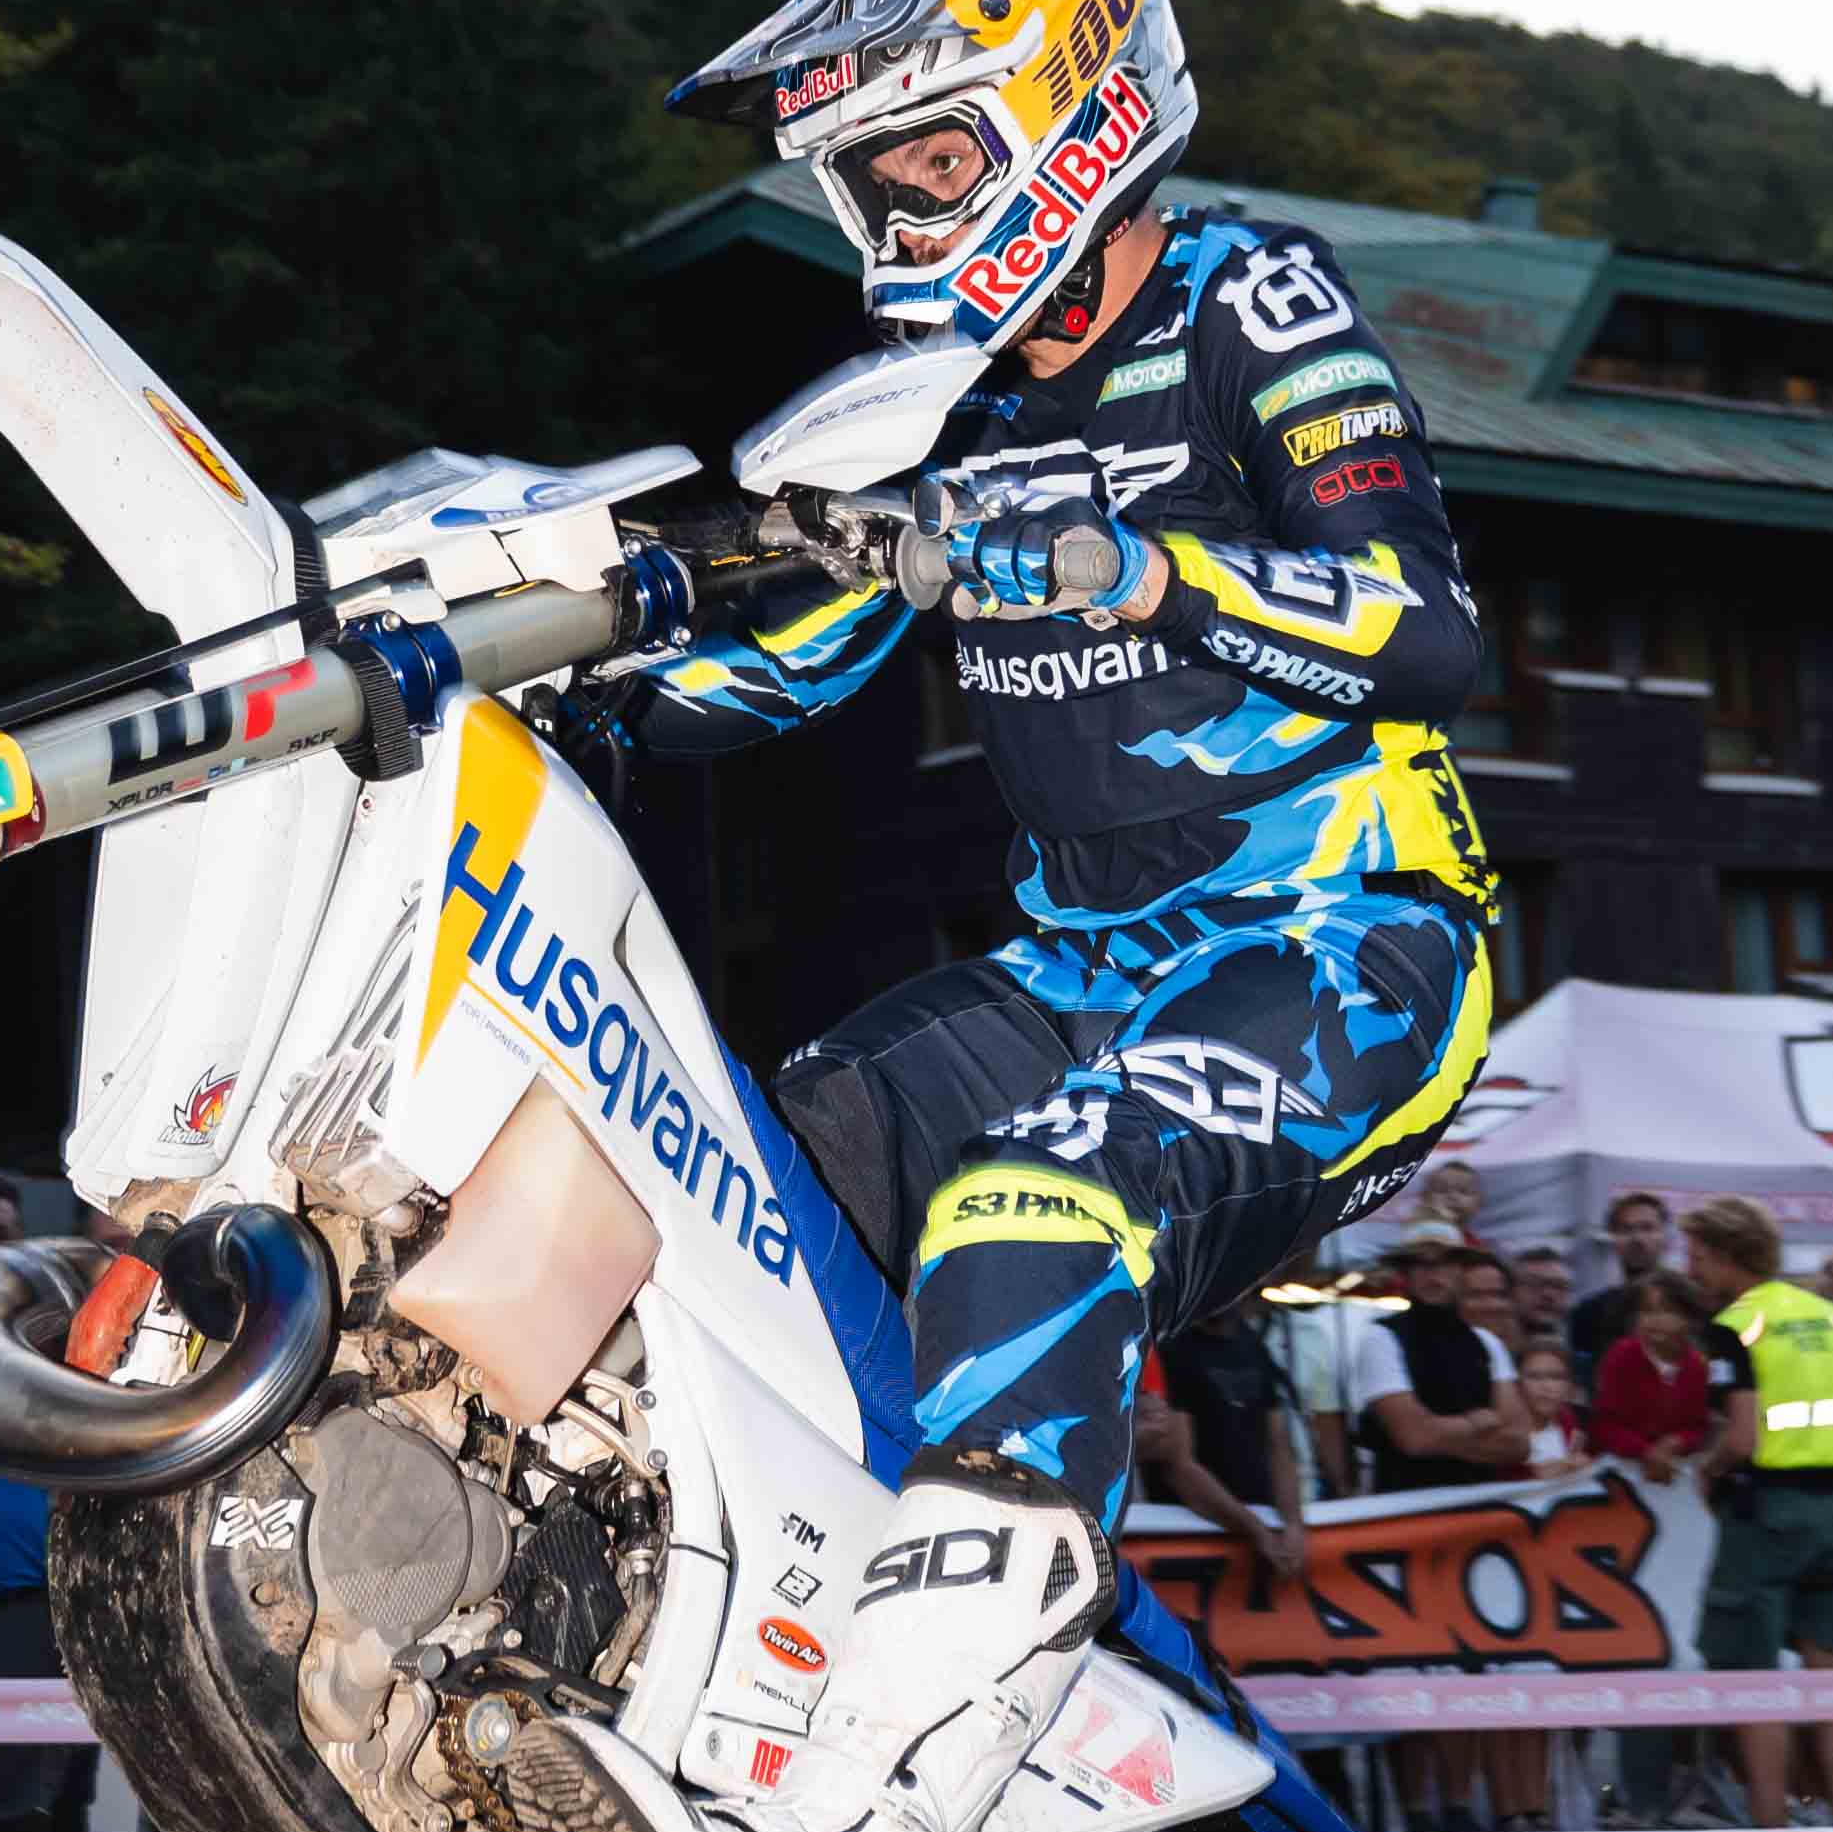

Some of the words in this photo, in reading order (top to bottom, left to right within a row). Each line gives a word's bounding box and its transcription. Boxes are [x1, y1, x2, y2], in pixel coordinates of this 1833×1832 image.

[952, 177, 1080, 318] Red
[1048, 70, 1153, 205] Bull
[1249, 644, 1375, 706] PARTS
[441, 821, 799, 1288] Husqvarna
[781, 1511, 828, 1554] FIM
[763, 1623, 800, 1656] Twin
[798, 1646, 825, 1667] Air
